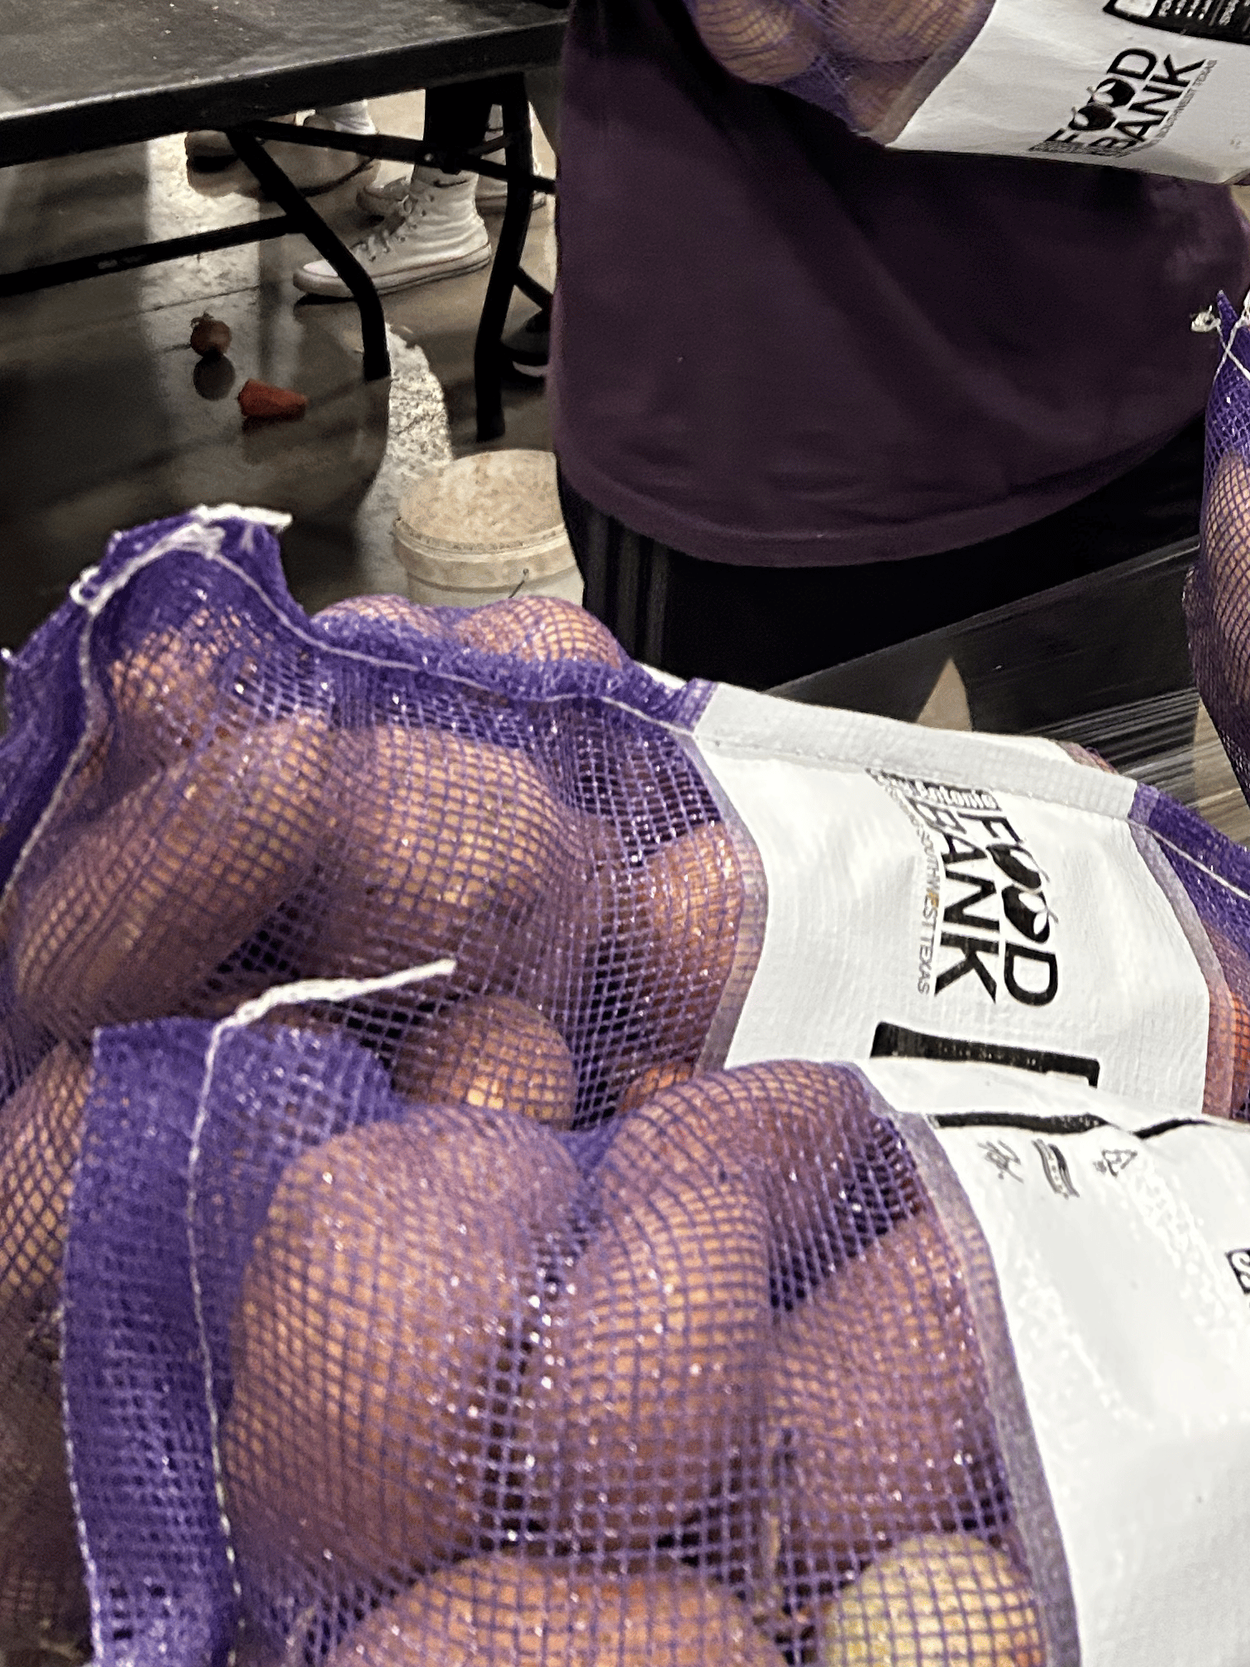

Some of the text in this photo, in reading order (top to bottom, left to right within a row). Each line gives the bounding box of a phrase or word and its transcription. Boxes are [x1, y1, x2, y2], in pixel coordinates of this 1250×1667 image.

[1090, 54, 1205, 148] BANK
[908, 797, 999, 1002] BANK
[919, 936, 933, 992] TEXAS
[959, 811, 1057, 1003] FOOD
